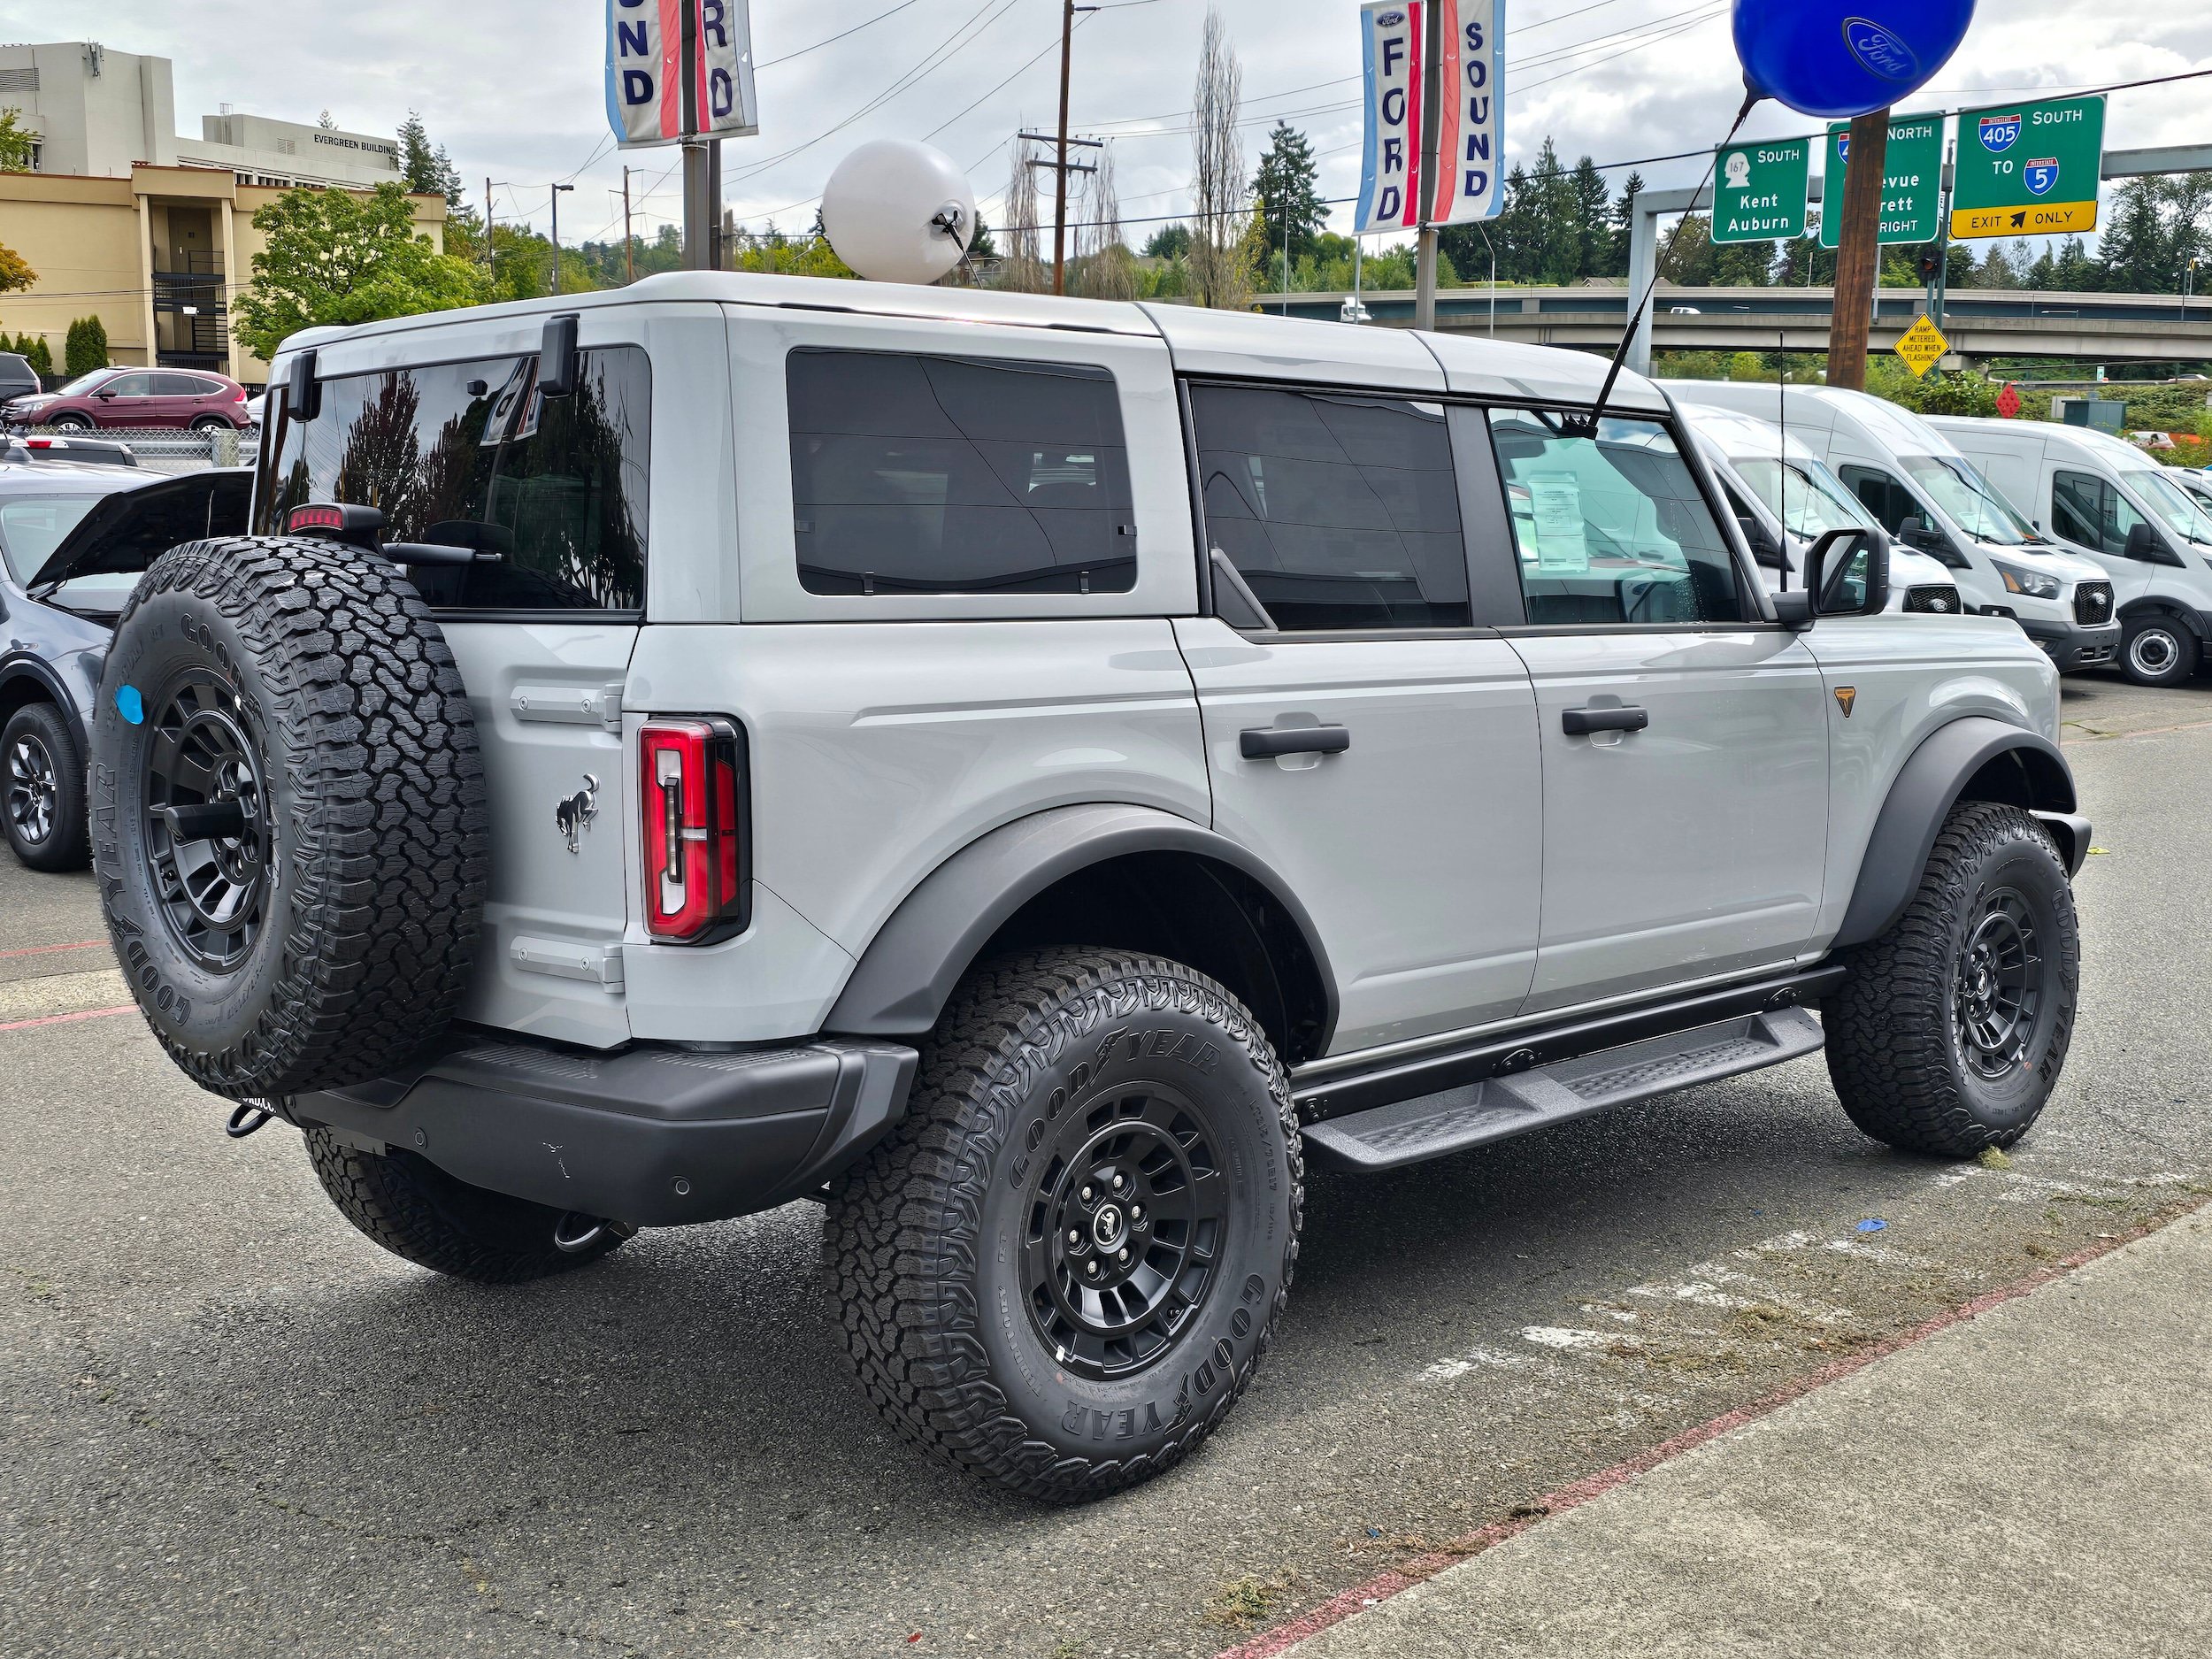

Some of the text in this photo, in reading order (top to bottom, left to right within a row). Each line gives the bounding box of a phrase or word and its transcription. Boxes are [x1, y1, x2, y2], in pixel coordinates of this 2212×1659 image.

[617, 0, 654, 105] ND
[1858, 35, 1908, 73] Ford
[1464, 22, 1490, 196] SOUND
[1377, 37, 1405, 221] FORD
[1887, 126, 1932, 142] NORTH
[1983, 109, 2083, 143] 405 SOUTH
[314, 134, 396, 156] EVERGREEN BUILDING
[1730, 149, 1800, 173] 167 SOUTH
[1993, 160, 2048, 189] TO 5
[1740, 193, 1778, 210] Kent
[1727, 217, 1789, 233] Auburn
[1880, 220, 1918, 233] RIGHT
[1971, 211, 2073, 228] EXIT ONLY
[1909, 334, 1936, 343] METERED
